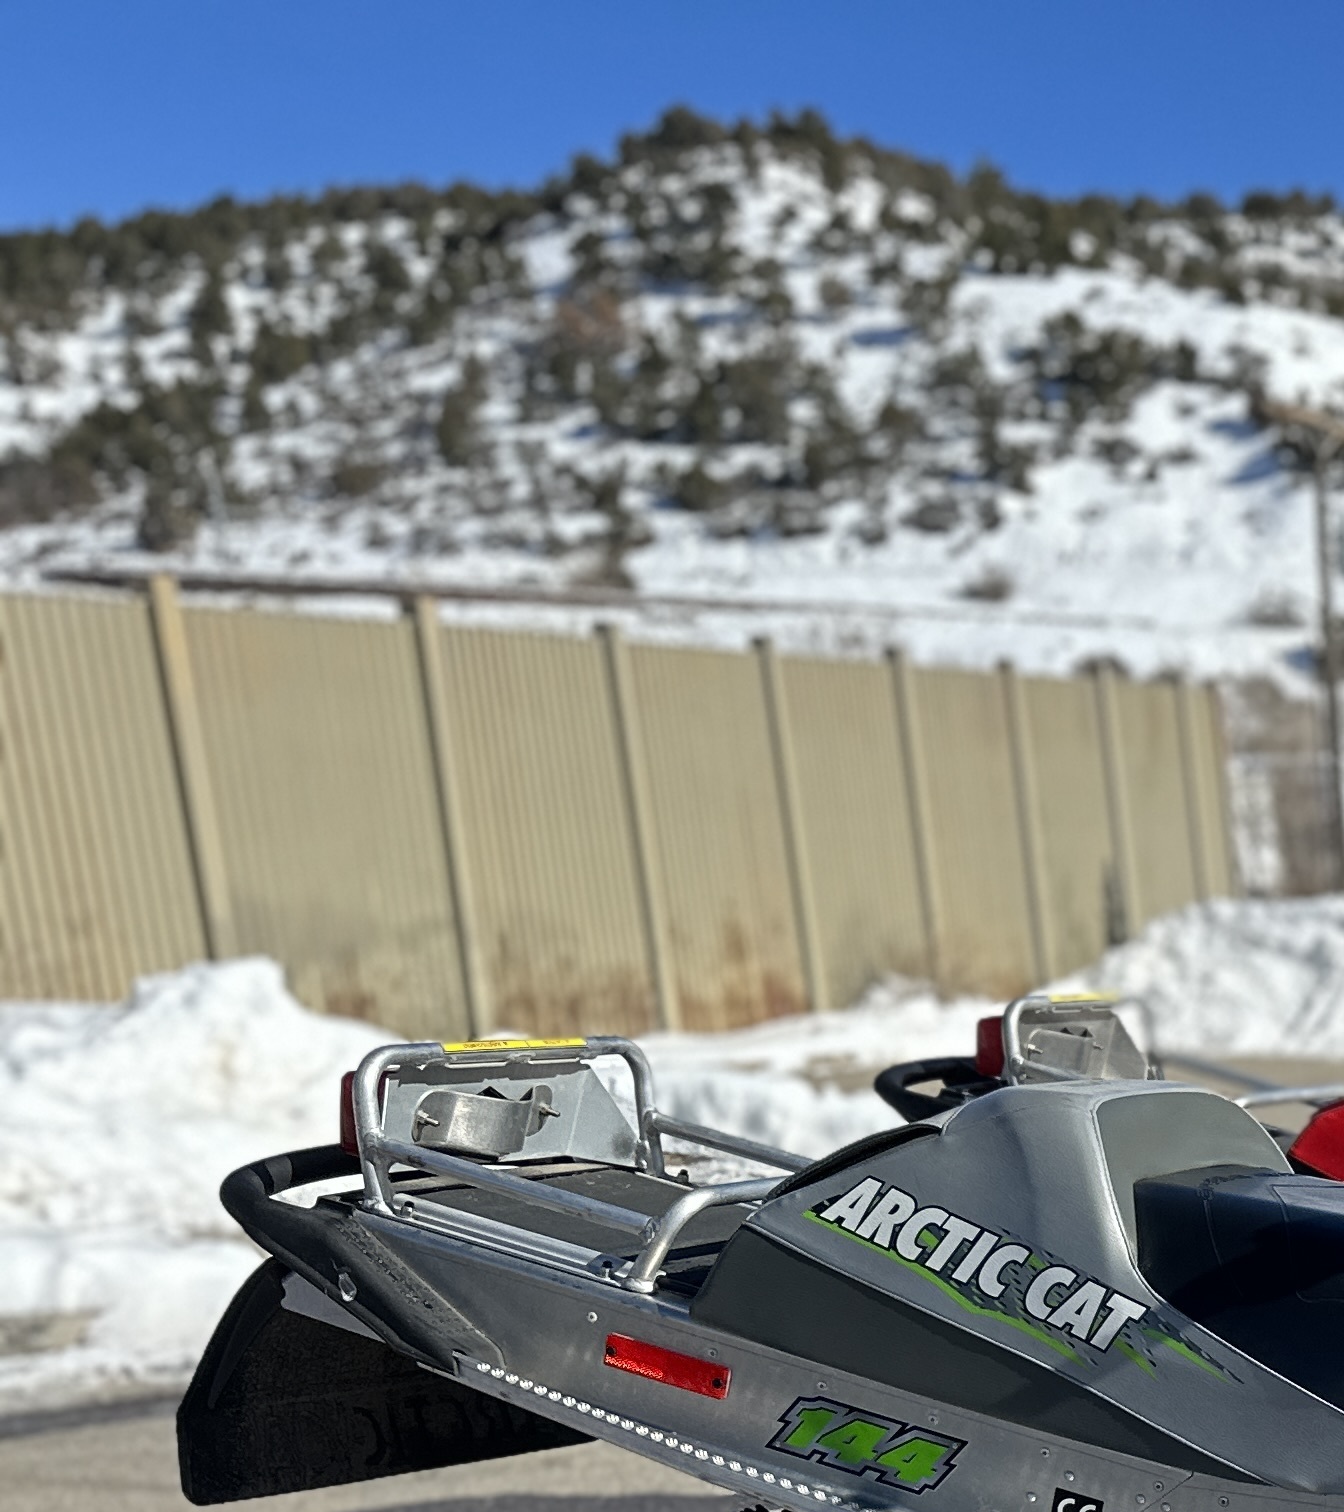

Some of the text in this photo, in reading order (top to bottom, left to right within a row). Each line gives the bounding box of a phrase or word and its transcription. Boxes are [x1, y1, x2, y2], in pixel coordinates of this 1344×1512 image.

[824, 1176, 1147, 1351] ARCTIC CAT
[784, 1407, 950, 1484] 144
